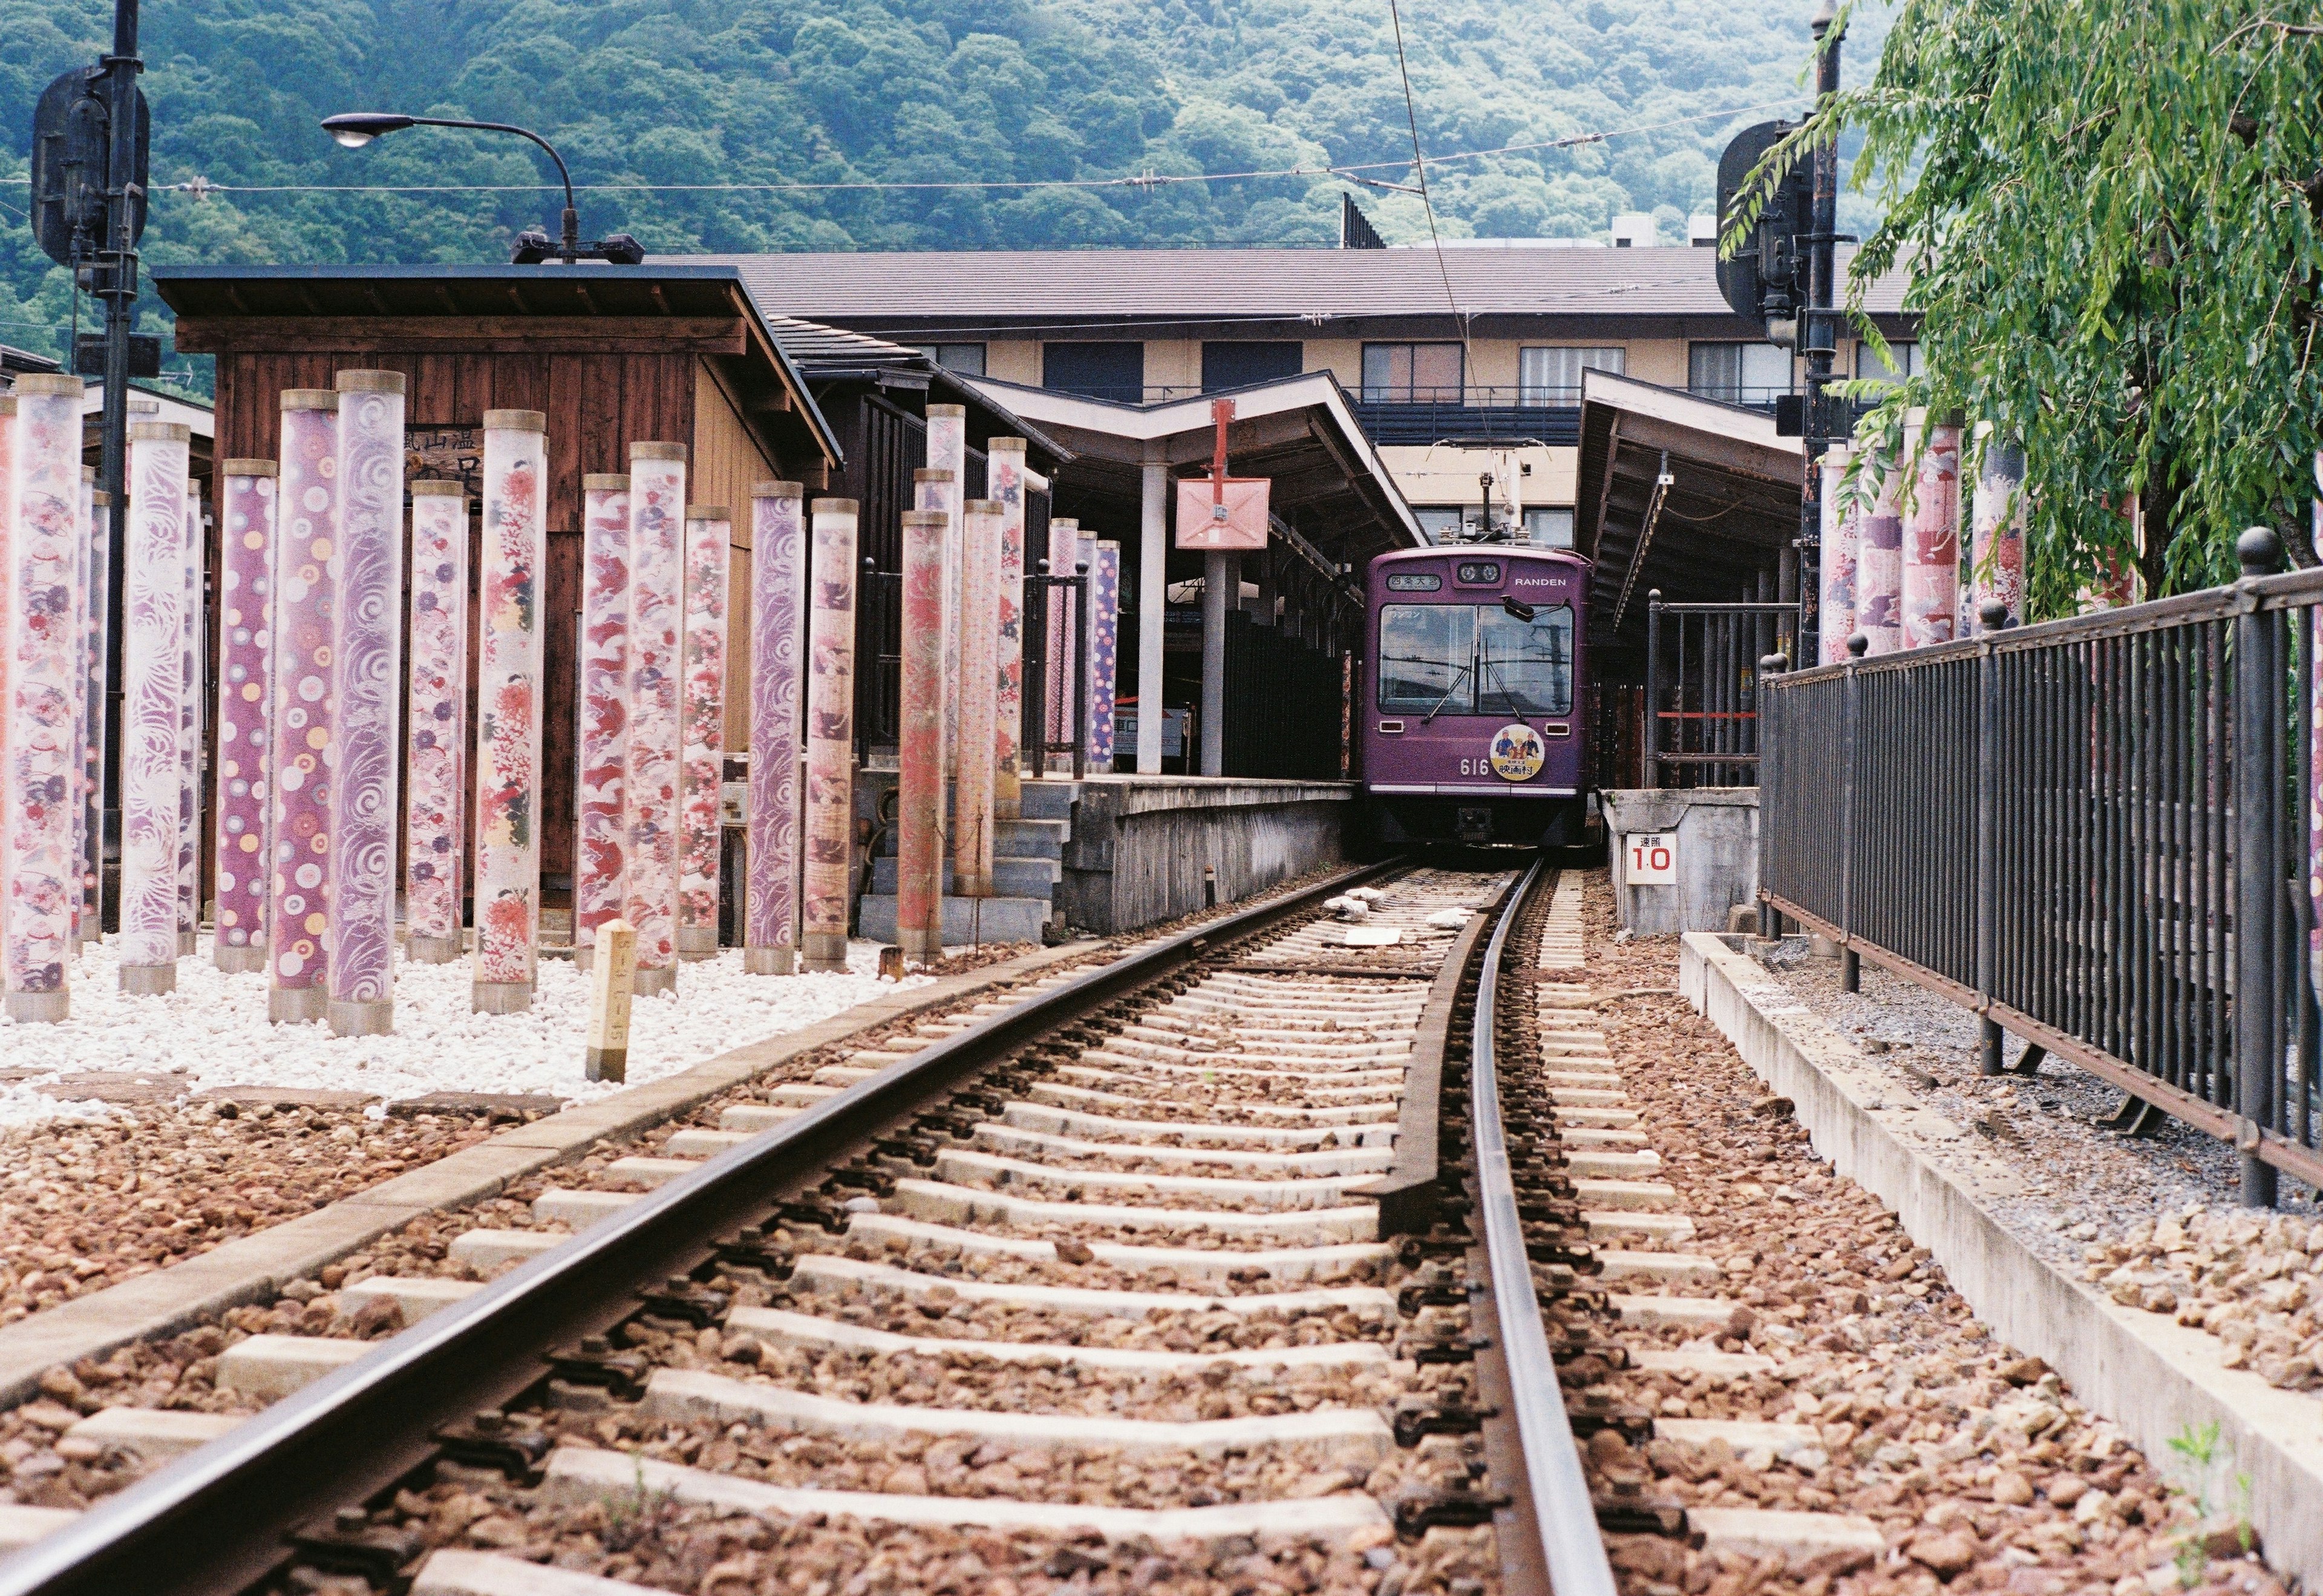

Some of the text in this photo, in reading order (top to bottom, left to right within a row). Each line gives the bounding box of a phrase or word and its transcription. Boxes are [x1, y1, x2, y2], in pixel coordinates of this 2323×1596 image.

[1460, 759, 1489, 775] 616
[1499, 764, 1534, 775] 映画村
[1640, 837, 1661, 847] 速照
[1633, 847, 1670, 870] 10
